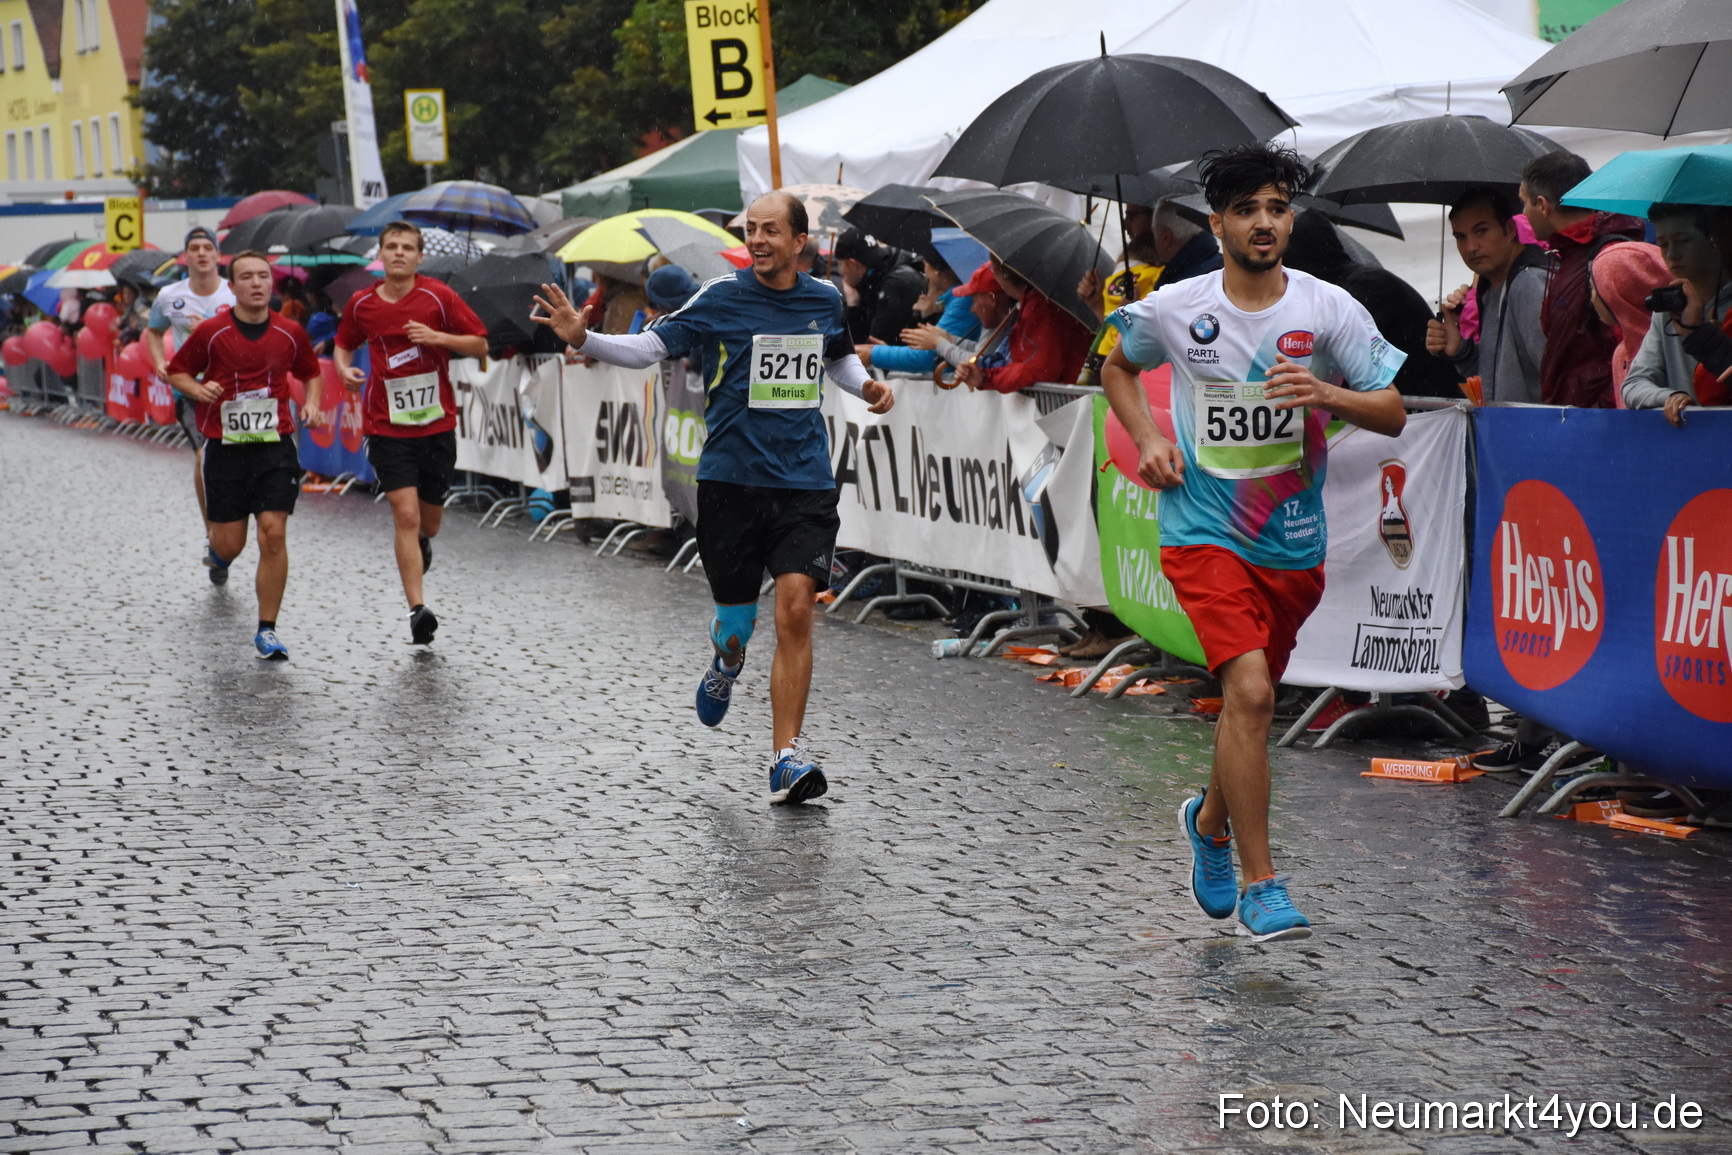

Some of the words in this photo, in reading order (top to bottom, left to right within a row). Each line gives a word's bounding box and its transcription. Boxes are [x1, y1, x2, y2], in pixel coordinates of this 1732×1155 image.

[696, 2, 761, 28] Block
[711, 38, 753, 100] B
[108, 199, 139, 210] Block
[115, 214, 134, 241] C
[1193, 314, 1219, 326] BMW
[786, 337, 819, 347] BOCK
[1187, 348, 1219, 358] PARTL
[759, 352, 818, 380] 5216
[1188, 356, 1220, 364] Neumarkt
[394, 385, 435, 410] 5177
[772, 386, 806, 398] Marius
[228, 411, 273, 431] 5072
[1207, 405, 1294, 442] 5302
[1283, 500, 1304, 518] 17.
[1501, 520, 1599, 651] Hervis
[1503, 629, 1553, 659] SPORTS
[1664, 654, 1727, 686] SPORTS
[1382, 762, 1433, 777] WERBUNG
